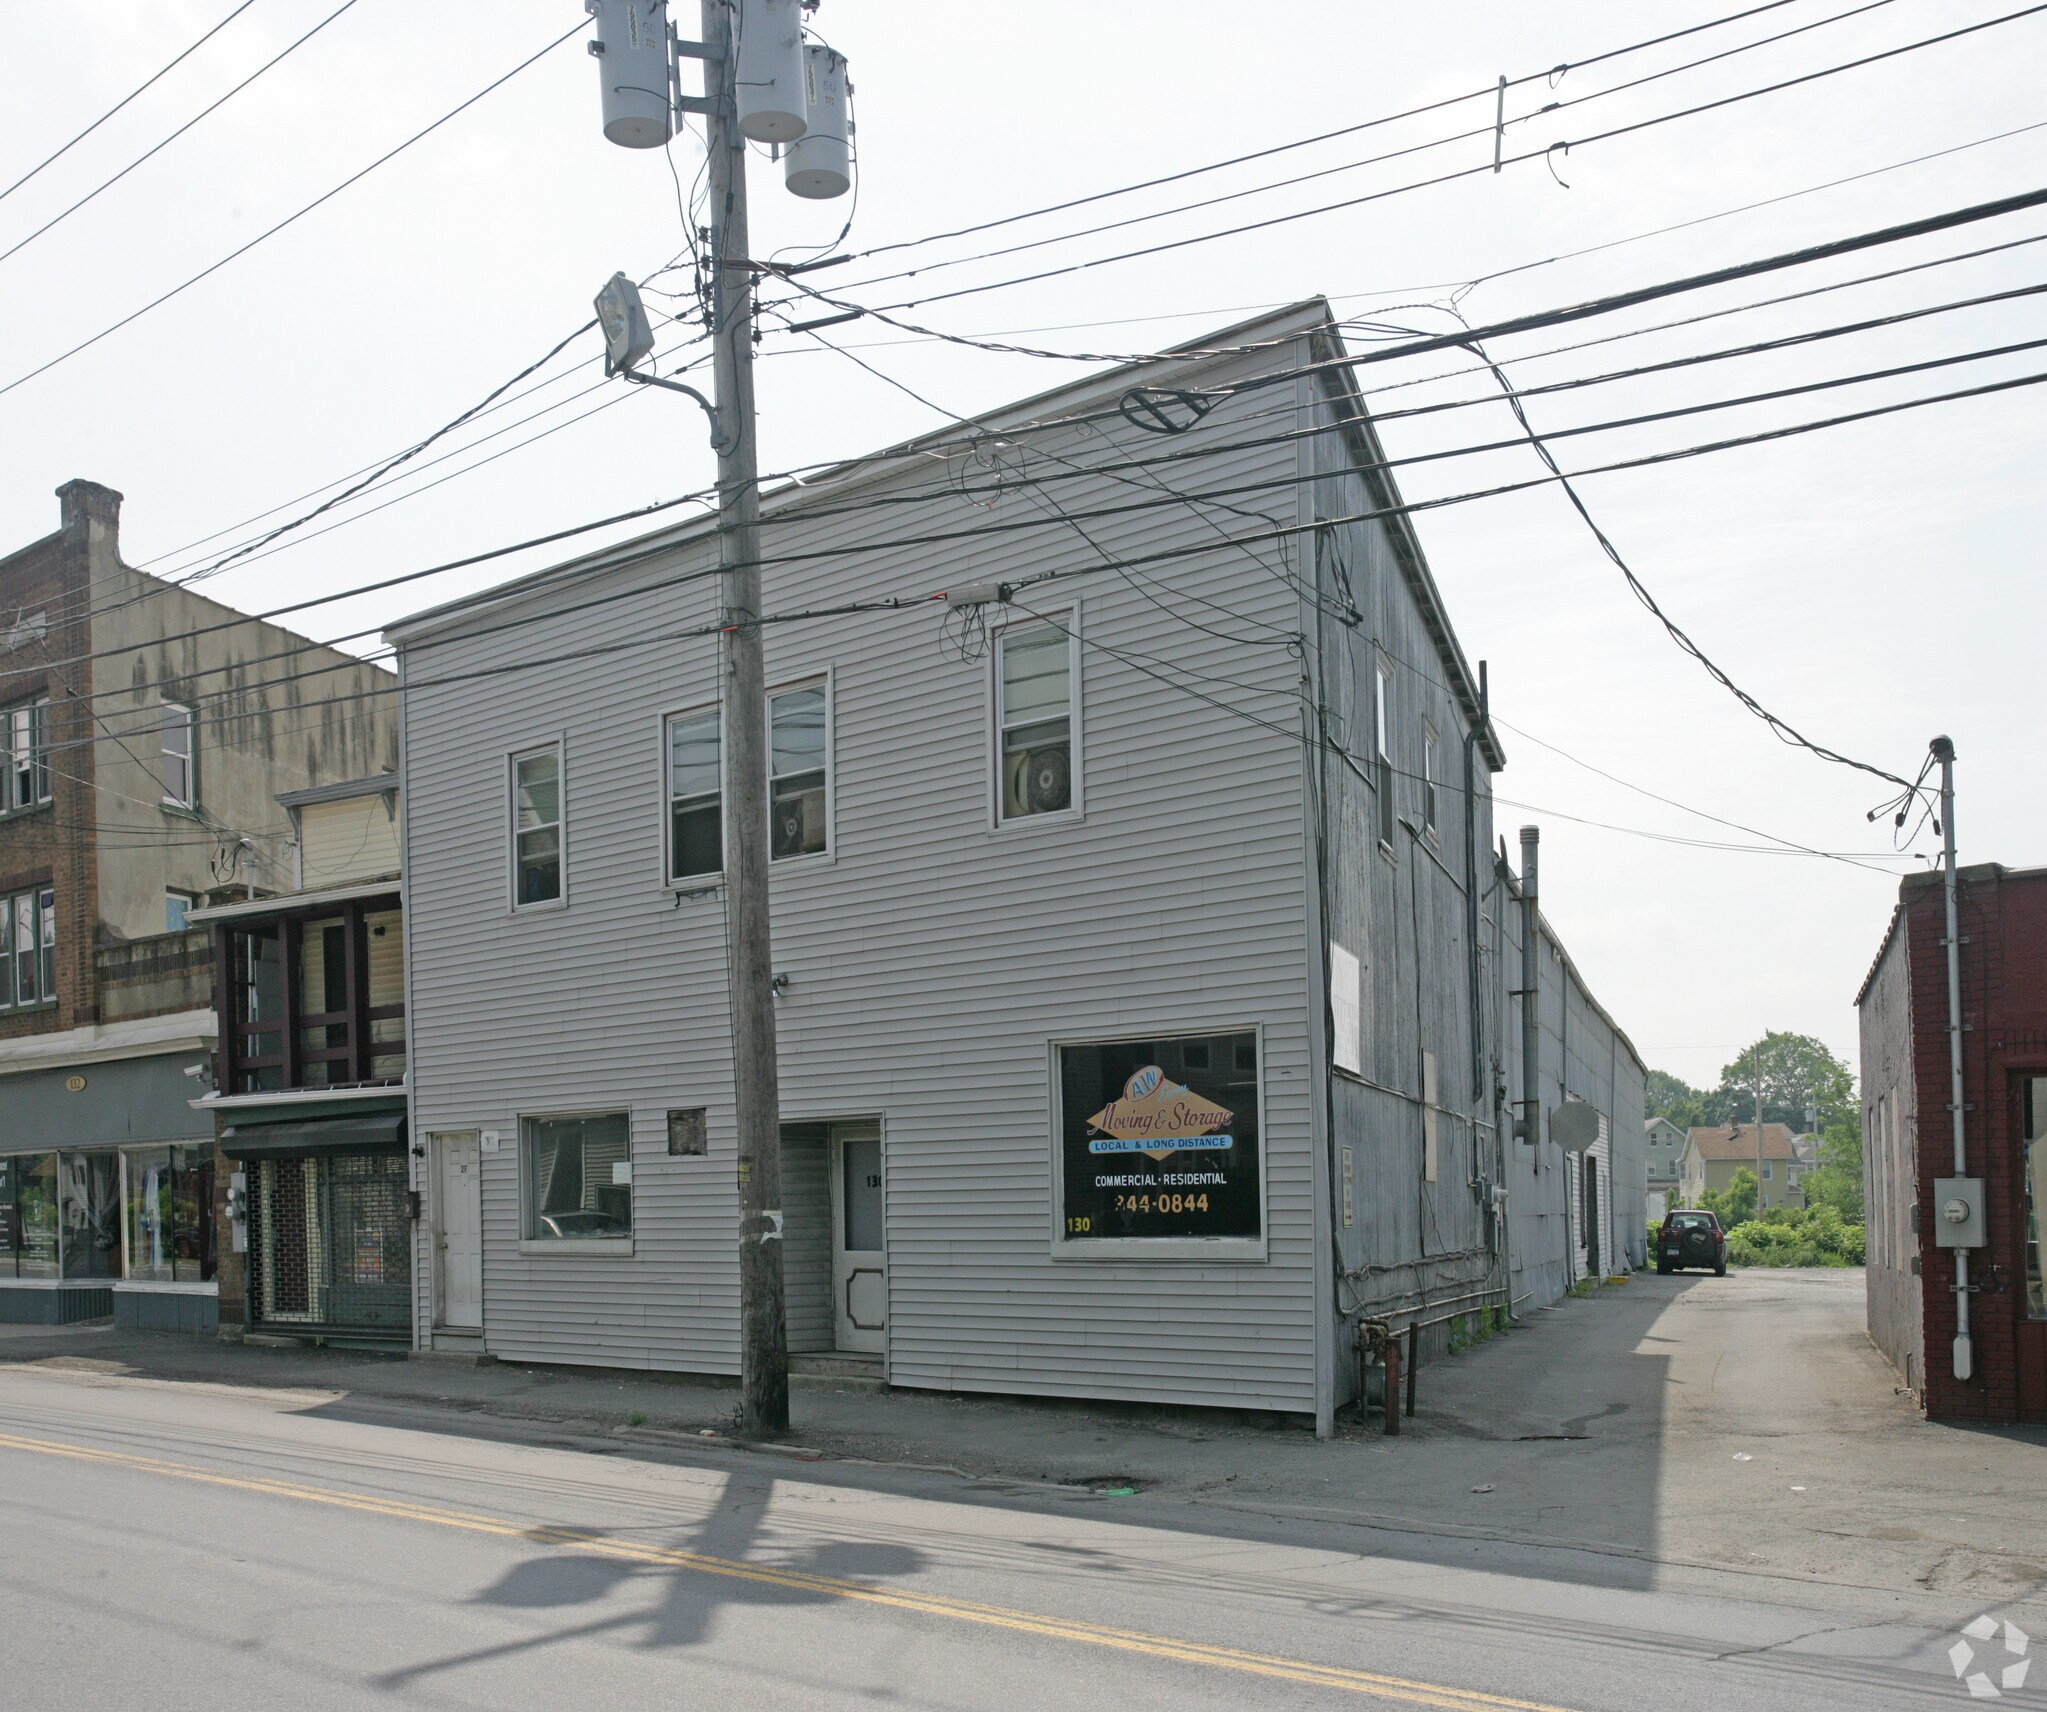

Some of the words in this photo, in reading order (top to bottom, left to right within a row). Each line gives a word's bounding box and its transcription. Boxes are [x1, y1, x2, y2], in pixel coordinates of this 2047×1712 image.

[1132, 1070, 1157, 1099] AW
[1087, 1103, 1153, 1136] Moving
[1155, 1109, 1167, 1130] &
[1168, 1101, 1231, 1131] Storage
[1095, 1140, 1129, 1151] LOCAL
[1135, 1141, 1142, 1150] &
[1146, 1139, 1175, 1149] LONG
[1178, 1137, 1226, 1148] DISTANCE
[1095, 1174, 1157, 1187] COMMERCIAL
[1163, 1172, 1227, 1186] RESIDENTIAL
[1067, 1217, 1091, 1232] 130
